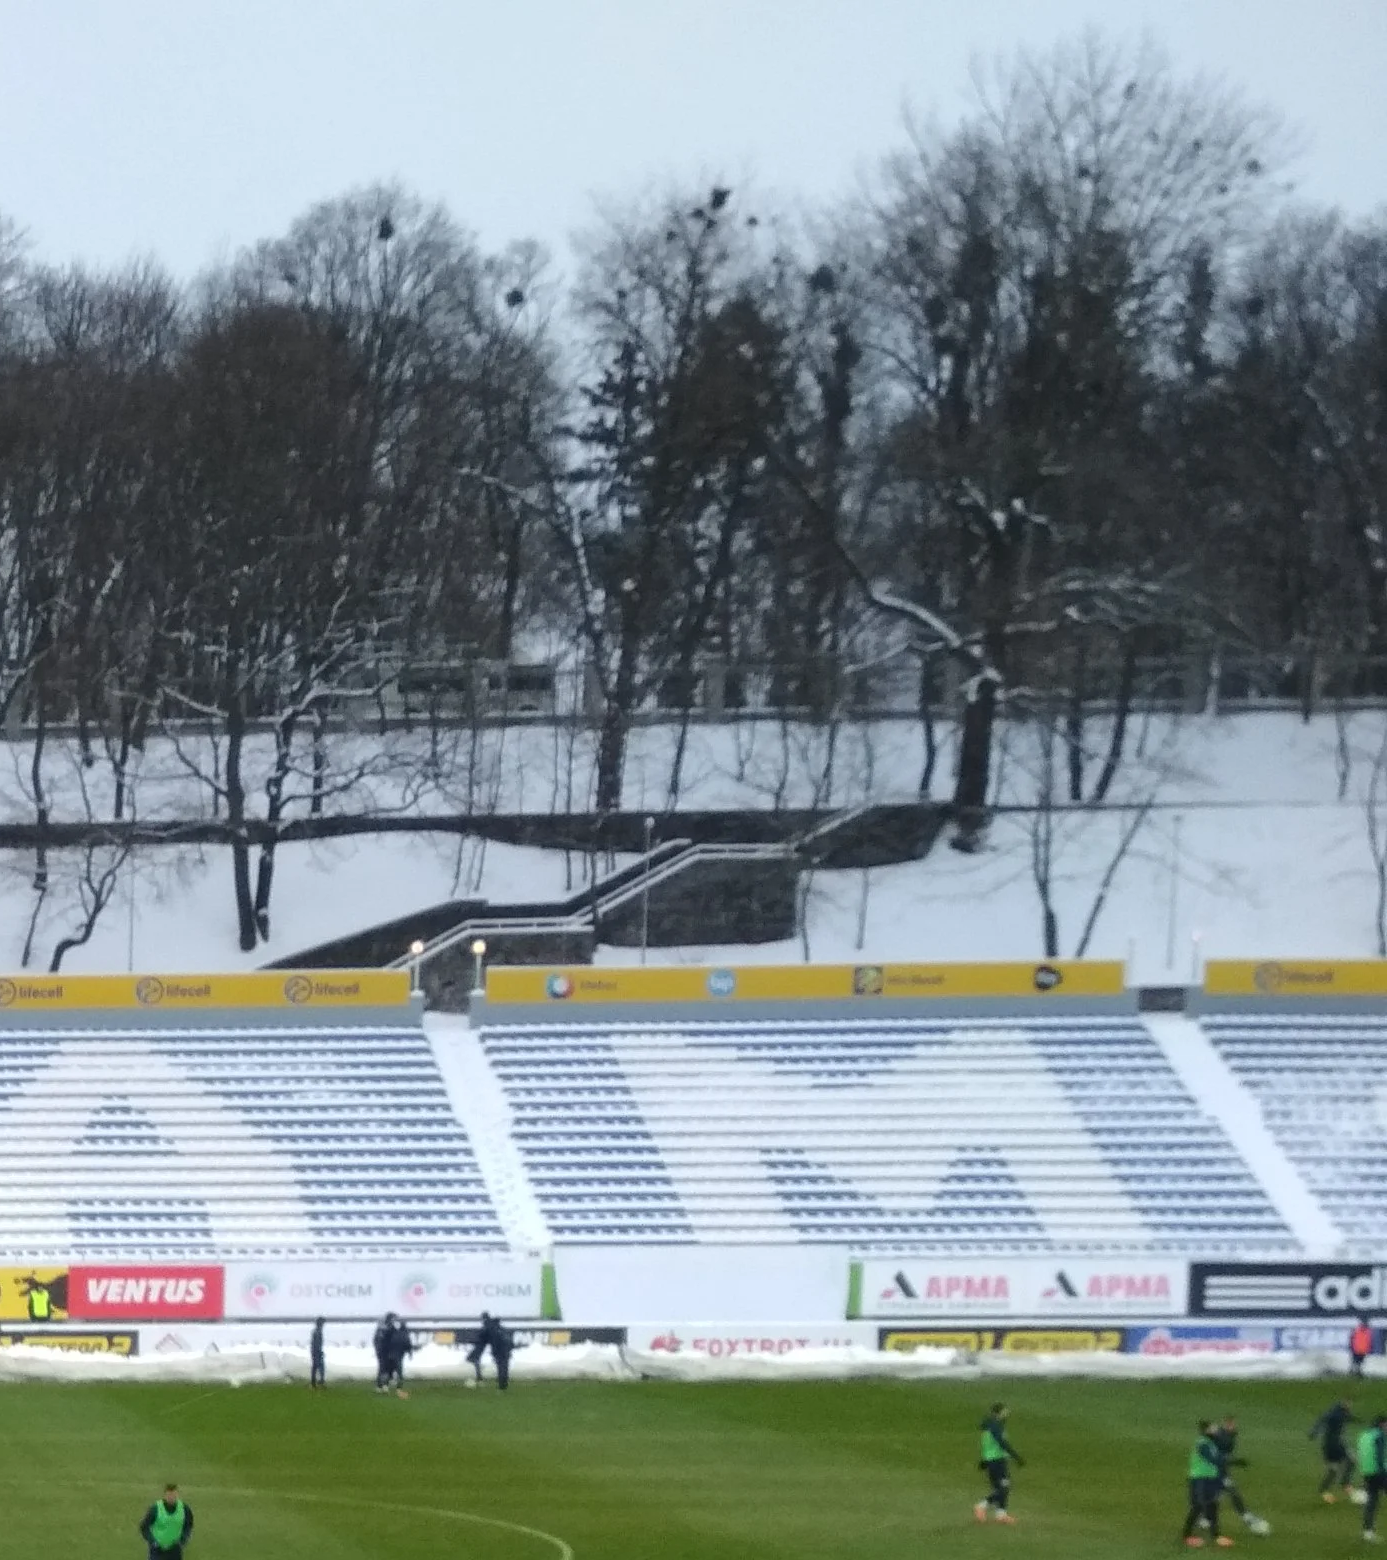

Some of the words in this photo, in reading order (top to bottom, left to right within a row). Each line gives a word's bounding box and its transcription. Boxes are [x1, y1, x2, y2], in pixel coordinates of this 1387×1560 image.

[19, 986, 63, 1000] lifecell
[166, 984, 211, 997] lifecell
[86, 1278, 206, 1304] VENTUS
[289, 1284, 373, 1298] OSTCHEM
[449, 1283, 532, 1298] OSTCHEM
[925, 1275, 1010, 1298] АРМА
[1087, 1274, 1171, 1297] АРМА
